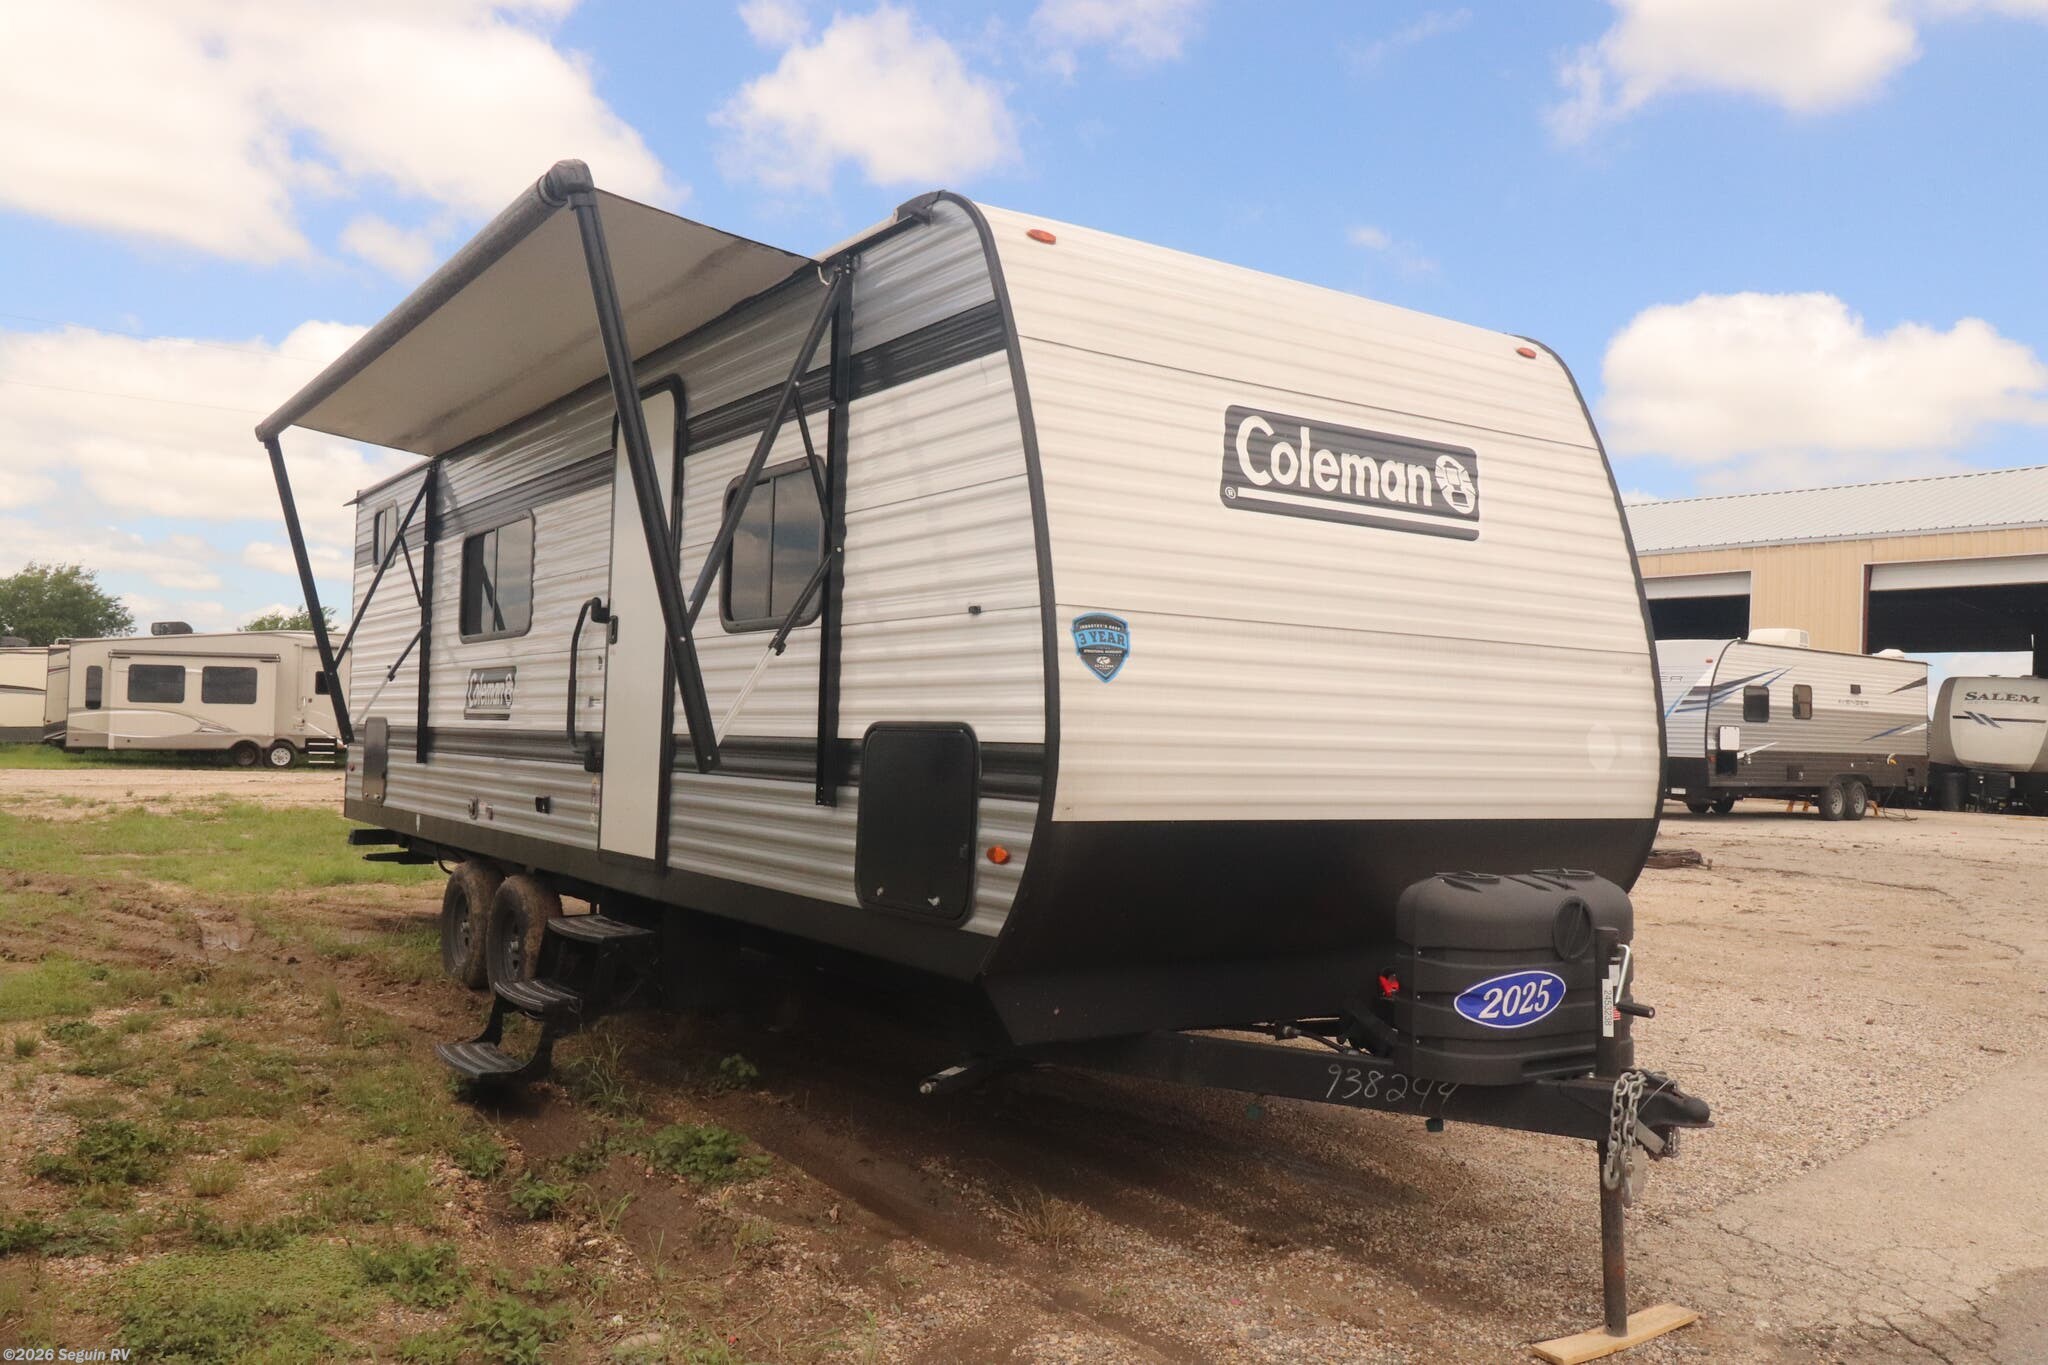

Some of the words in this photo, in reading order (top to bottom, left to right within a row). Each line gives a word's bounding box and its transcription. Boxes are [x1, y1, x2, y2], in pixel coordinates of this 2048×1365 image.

[1236, 415, 1432, 507] Coleman
[1078, 633, 1087, 645] 3
[1088, 631, 1126, 646] YEAR
[468, 672, 505, 708] Coleman
[1964, 691, 2041, 705] SALEM
[1478, 978, 1553, 1020] 2025
